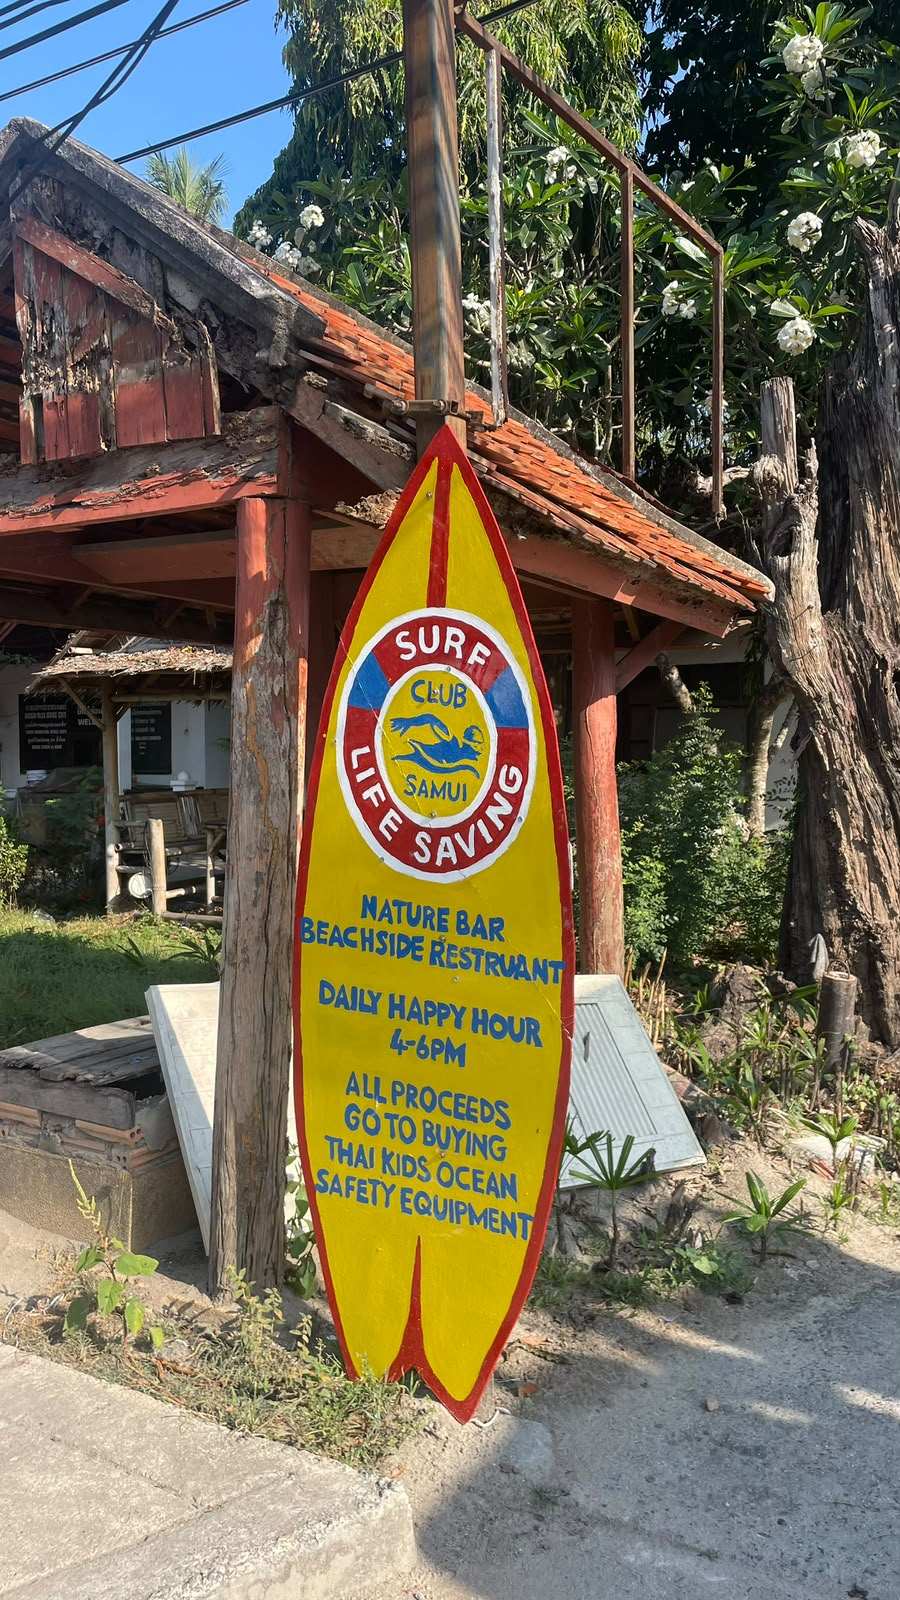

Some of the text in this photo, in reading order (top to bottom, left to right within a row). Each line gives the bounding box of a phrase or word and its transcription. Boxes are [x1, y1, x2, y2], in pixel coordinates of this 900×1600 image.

[395, 625, 491, 667] SURF
[411, 679, 468, 709] CLUB
[351, 745, 523, 867] LIFE SAVING
[404, 774, 468, 802] SAMUI
[360, 894, 505, 942] NATURE BAR
[300, 917, 566, 985] BEACHSIDE RESTRUANT
[319, 979, 543, 1048] DAILY HAPPY HOUR
[390, 1028, 467, 1068] 4-6PM
[345, 1071, 512, 1130] ALL PROCEEDS
[344, 1103, 507, 1161] GO TO BUYING
[324, 1135, 518, 1202] THAI KIDS OCEAN
[315, 1168, 535, 1240] SAFETY EQUIPMENT
